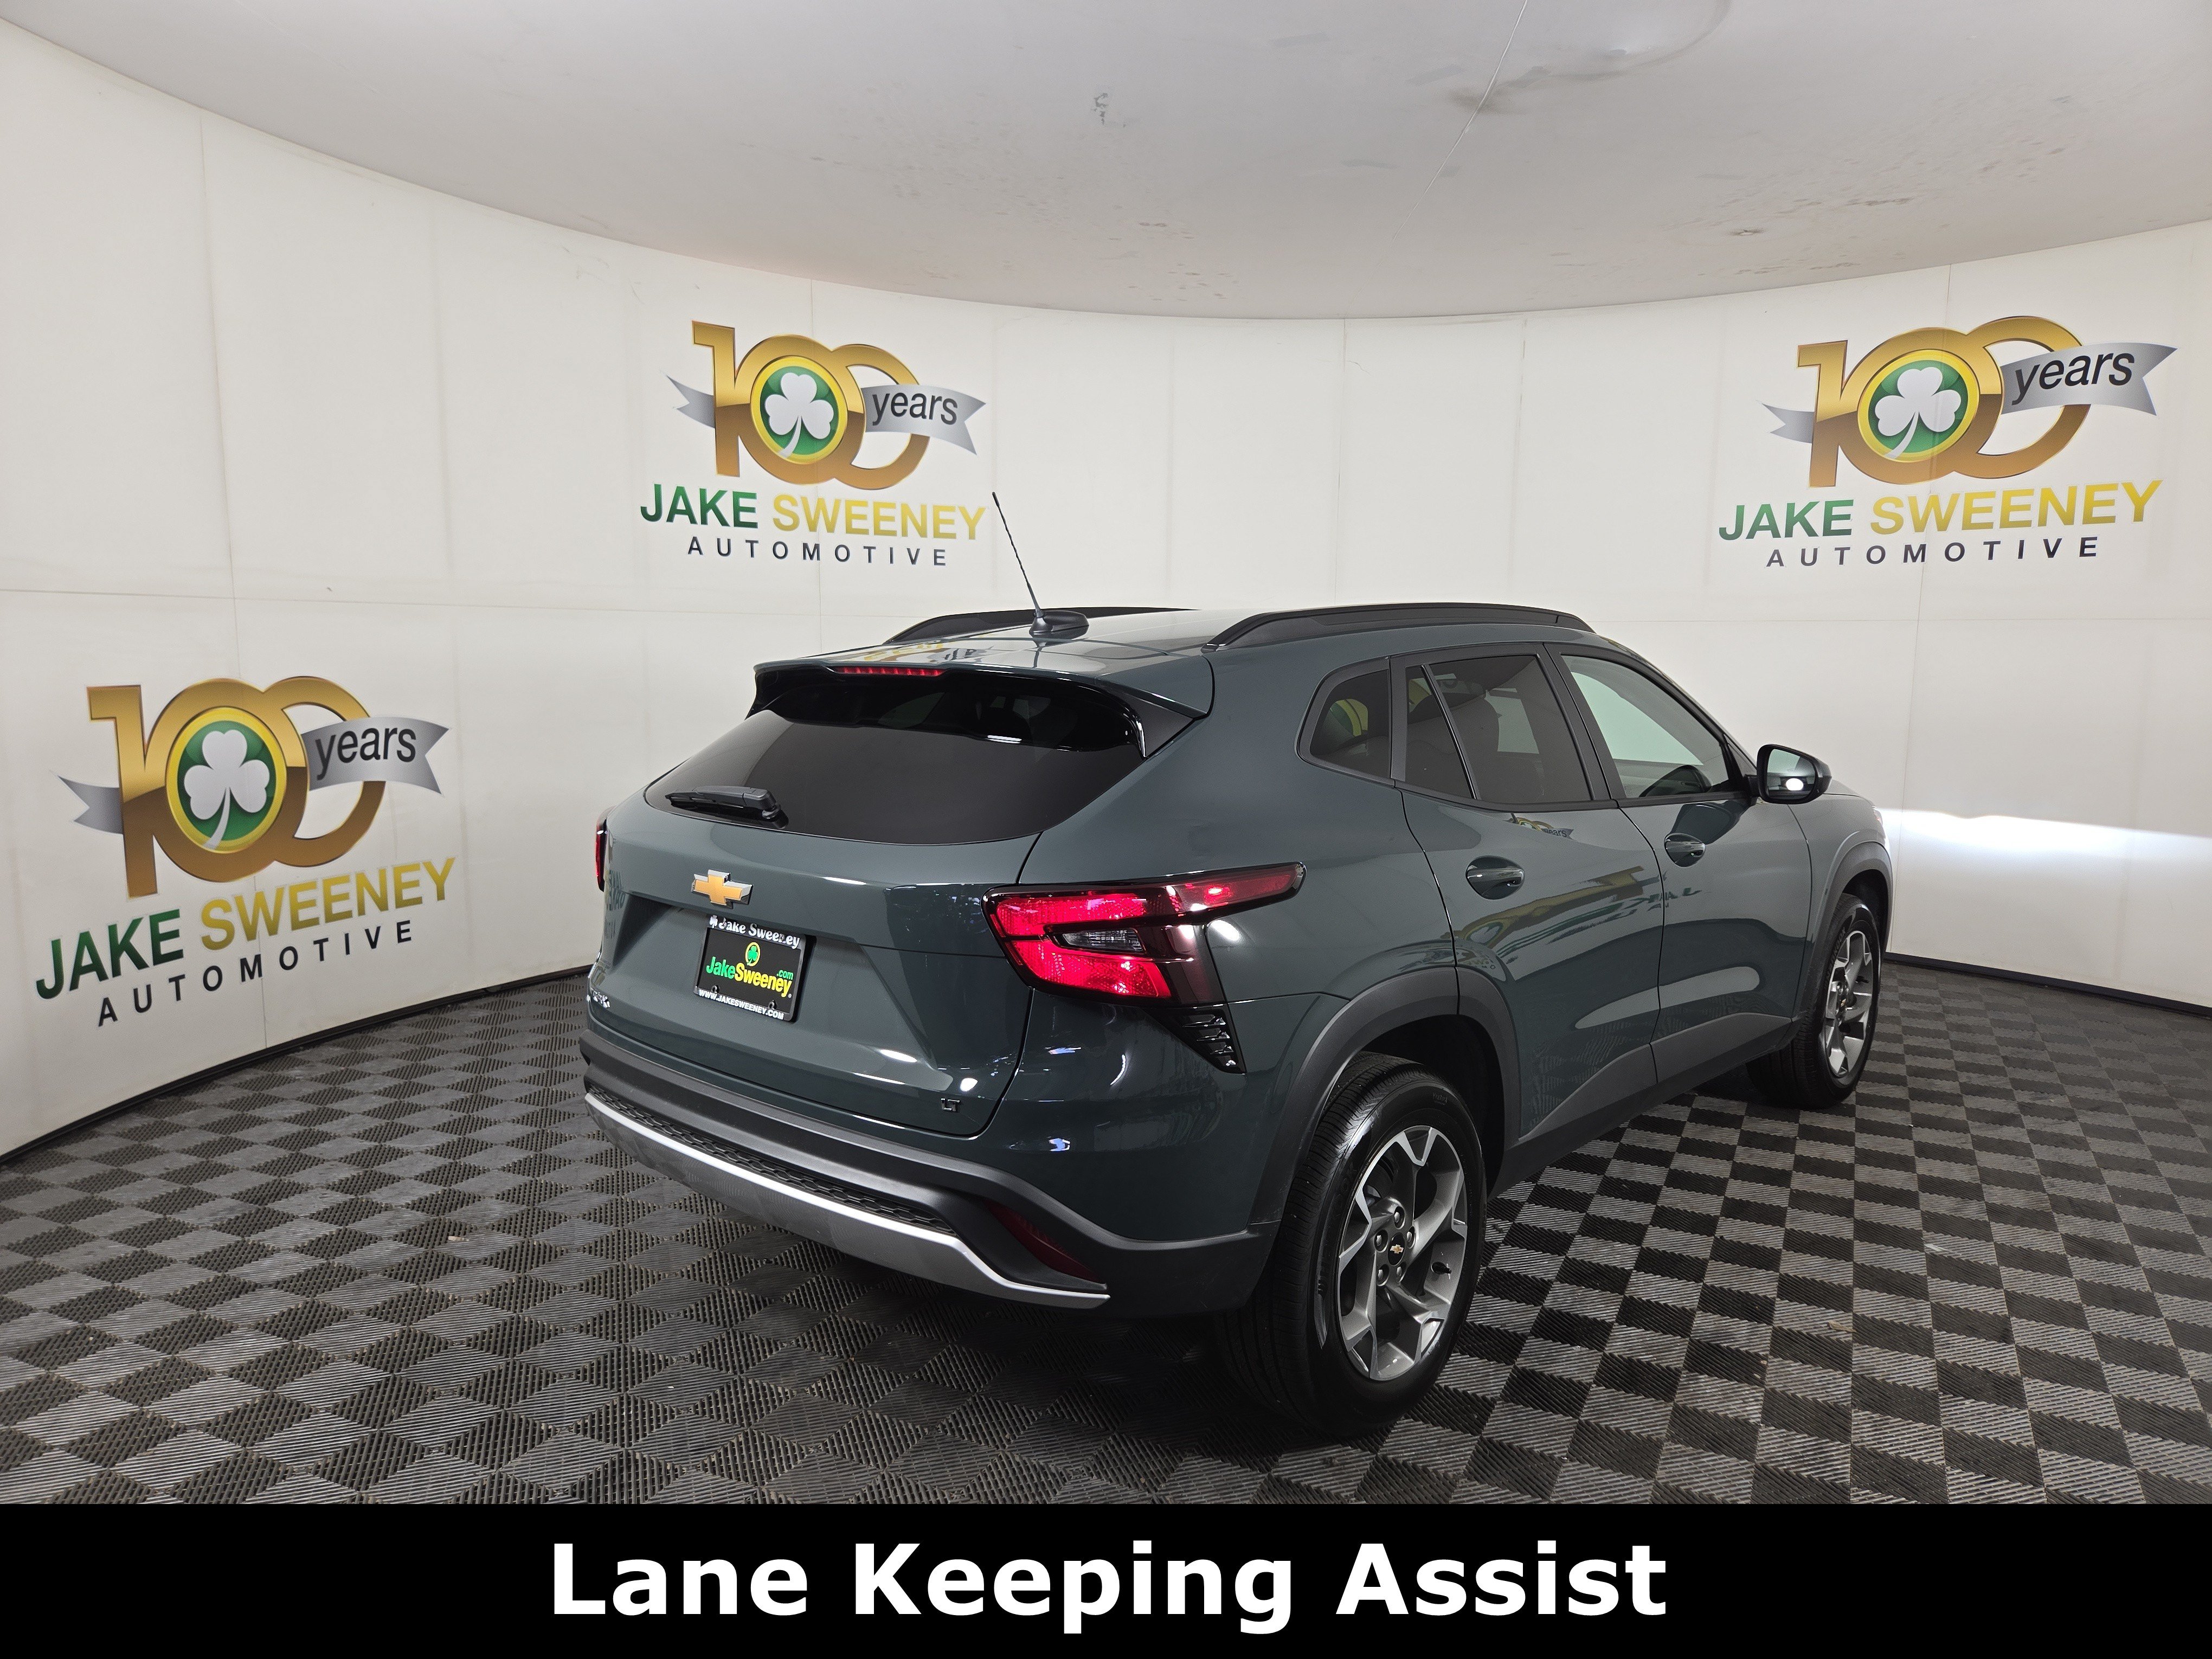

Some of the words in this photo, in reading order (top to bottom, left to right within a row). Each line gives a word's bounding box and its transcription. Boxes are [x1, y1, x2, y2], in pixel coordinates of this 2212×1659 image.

[2011, 352, 2135, 406] years
[872, 391, 958, 426] years
[640, 484, 758, 529] JAKE
[773, 494, 986, 541] SWEENEY
[1719, 499, 1854, 541] JAKE
[1871, 479, 2163, 535] SWEENEY
[688, 536, 946, 566] AUTOMOTIVE
[1766, 536, 2098, 568] AUTOMOTIVE
[315, 726, 417, 780] years
[35, 909, 184, 999] JAKE
[201, 858, 455, 951] SWEENEY
[718, 917, 746, 934] Jake
[748, 923, 800, 949] Sweeney
[98, 920, 412, 1026] AUTOMOTIVE
[699, 989, 784, 1020] WWW.JAKESWEENEY.COM
[941, 1098, 960, 1112] LT
